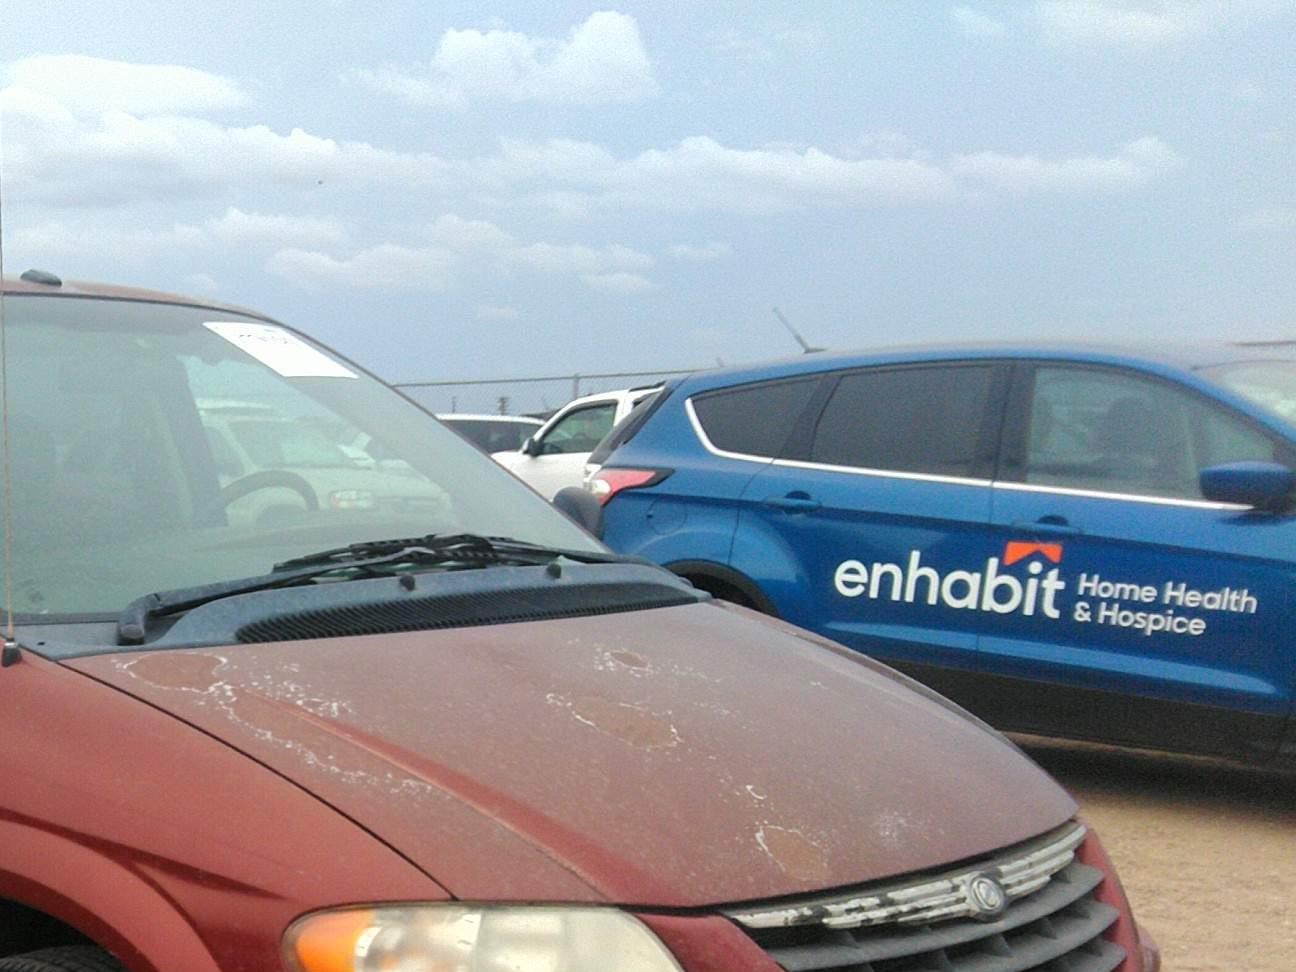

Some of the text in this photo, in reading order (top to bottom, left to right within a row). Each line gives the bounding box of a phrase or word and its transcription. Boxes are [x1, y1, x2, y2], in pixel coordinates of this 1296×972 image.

[834, 550, 1065, 618] enhabit
[1078, 573, 1258, 614] Home Health
[1074, 603, 1206, 636] & Hospice
